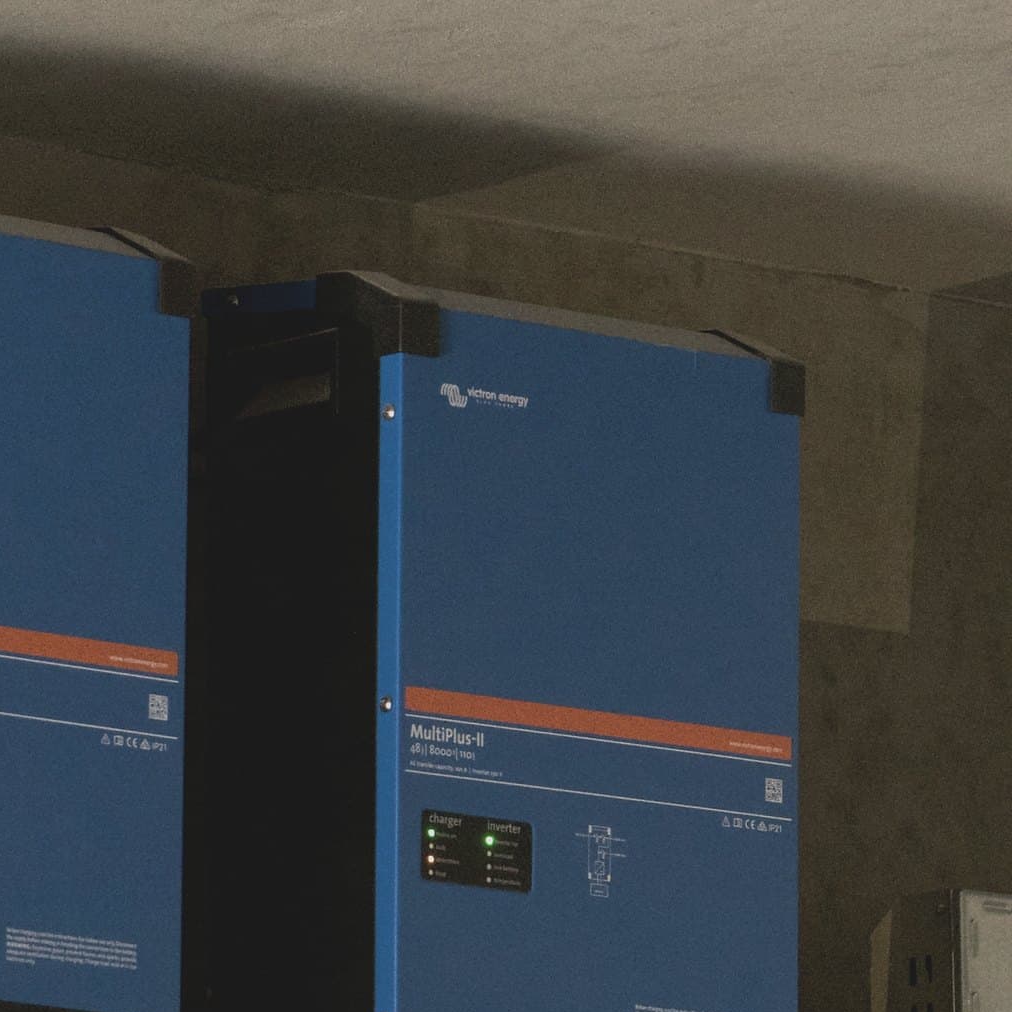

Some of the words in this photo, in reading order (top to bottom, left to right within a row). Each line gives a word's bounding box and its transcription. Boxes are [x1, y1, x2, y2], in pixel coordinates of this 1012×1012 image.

[467, 386, 496, 400] victron
[498, 393, 528, 408] energy
[410, 723, 485, 747] MultiPlus-II
[429, 812, 462, 829] charger
[488, 820, 521, 834] inverter
